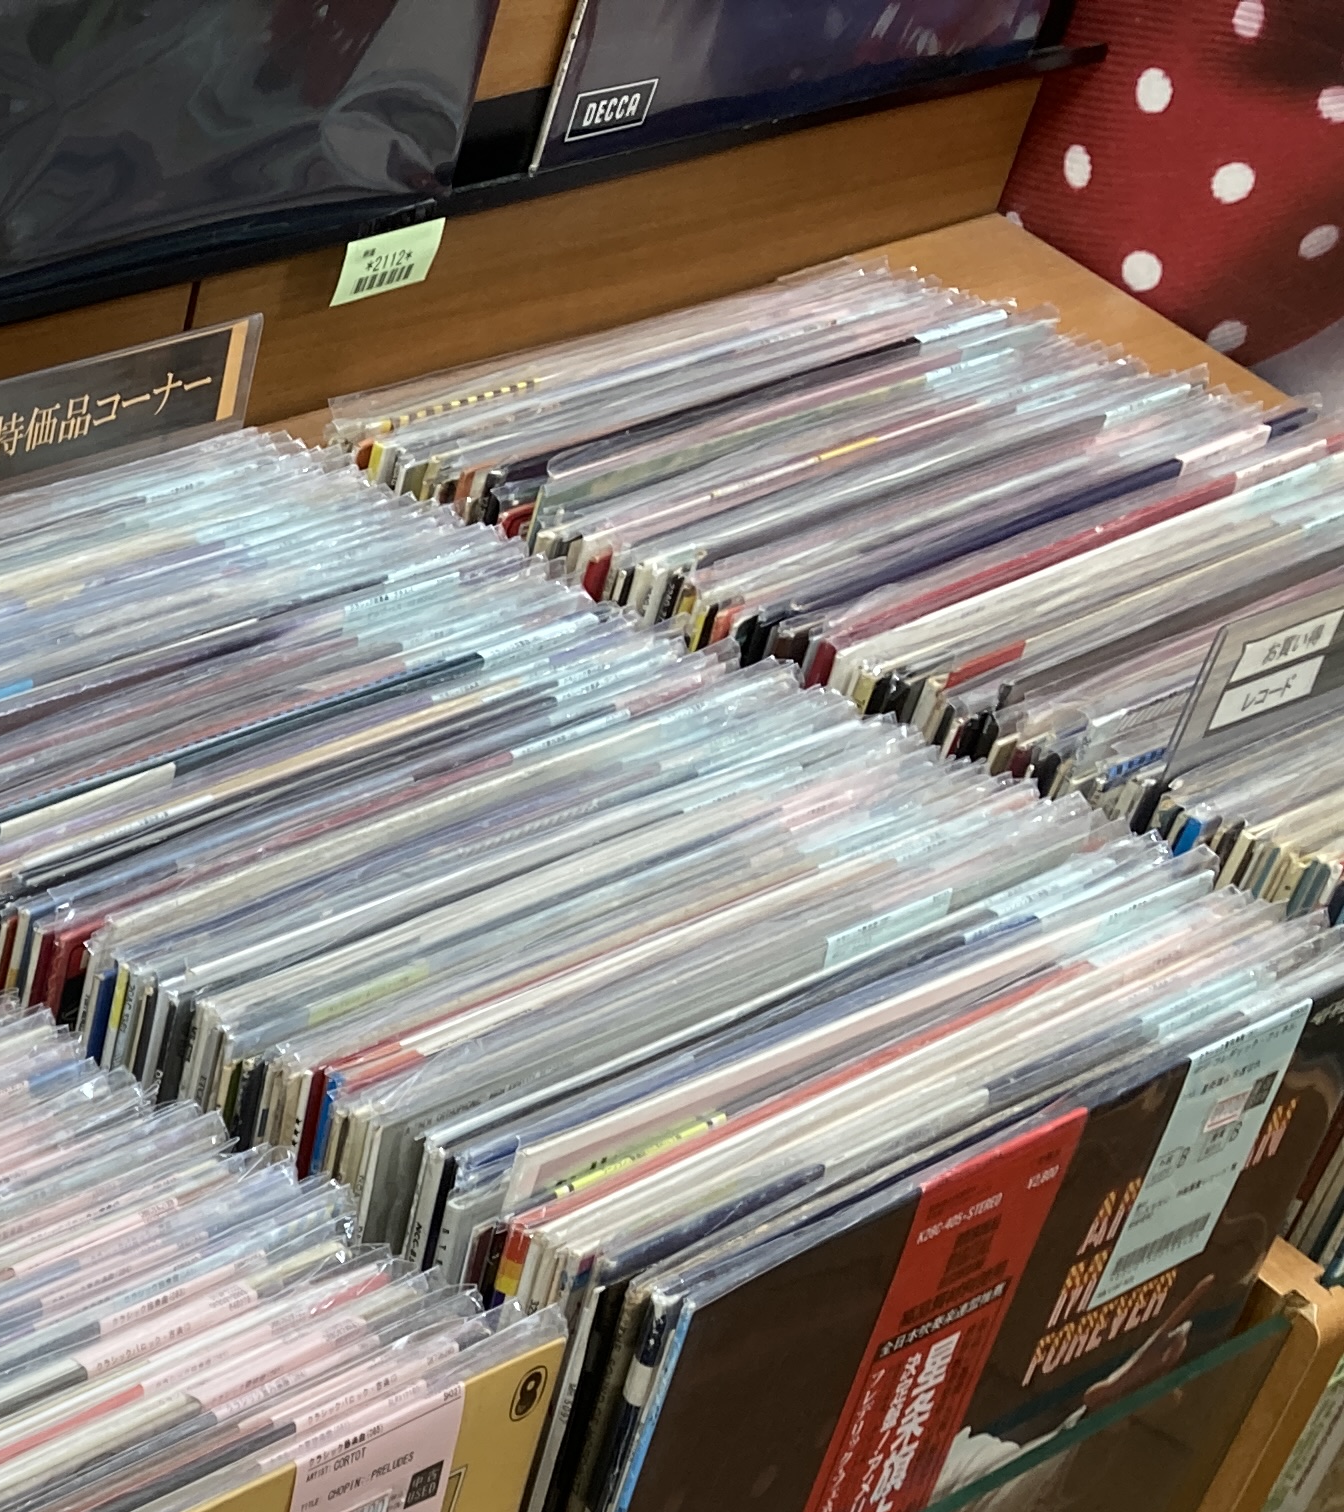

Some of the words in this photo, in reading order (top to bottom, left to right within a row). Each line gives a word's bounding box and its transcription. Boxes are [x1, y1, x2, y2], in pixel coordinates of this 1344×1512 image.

[582, 92, 641, 127] DECCA
[1241, 673, 1297, 712] レコード
[333, 1447, 367, 1473] CORTOT
[407, 1482, 436, 1502] USED
